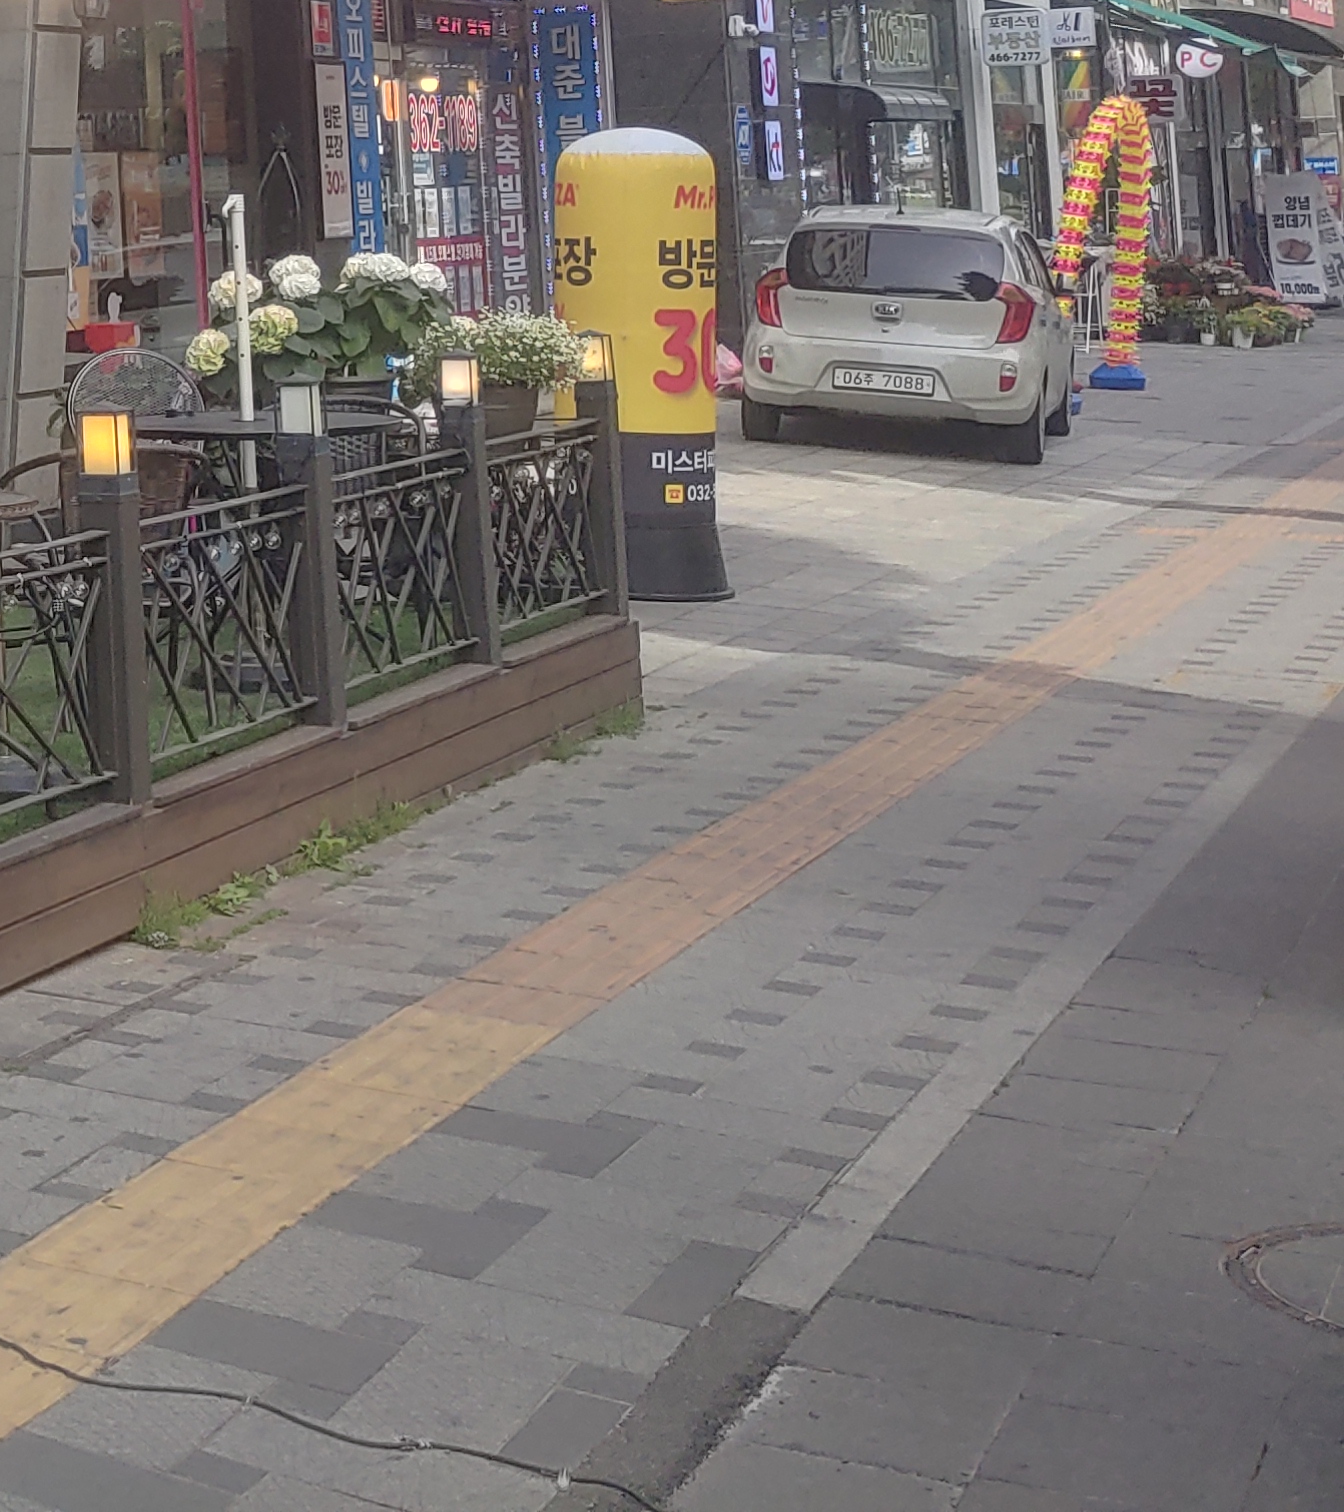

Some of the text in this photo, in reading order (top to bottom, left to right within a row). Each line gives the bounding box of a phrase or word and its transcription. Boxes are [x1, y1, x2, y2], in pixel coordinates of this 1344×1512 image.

[988, 16, 1040, 30] 포레스턴
[987, 30, 1041, 51] 부동산
[549, 24, 586, 100] 대준
[988, 51, 1041, 63] 466-7277
[408, 92, 478, 153] 362-1189
[1284, 195, 1310, 211] 양념
[356, 180, 376, 253] 빌라
[1272, 214, 1312, 229] 껍데기
[843, 371, 925, 391] 06주 7088
[687, 482, 716, 503] 032-
